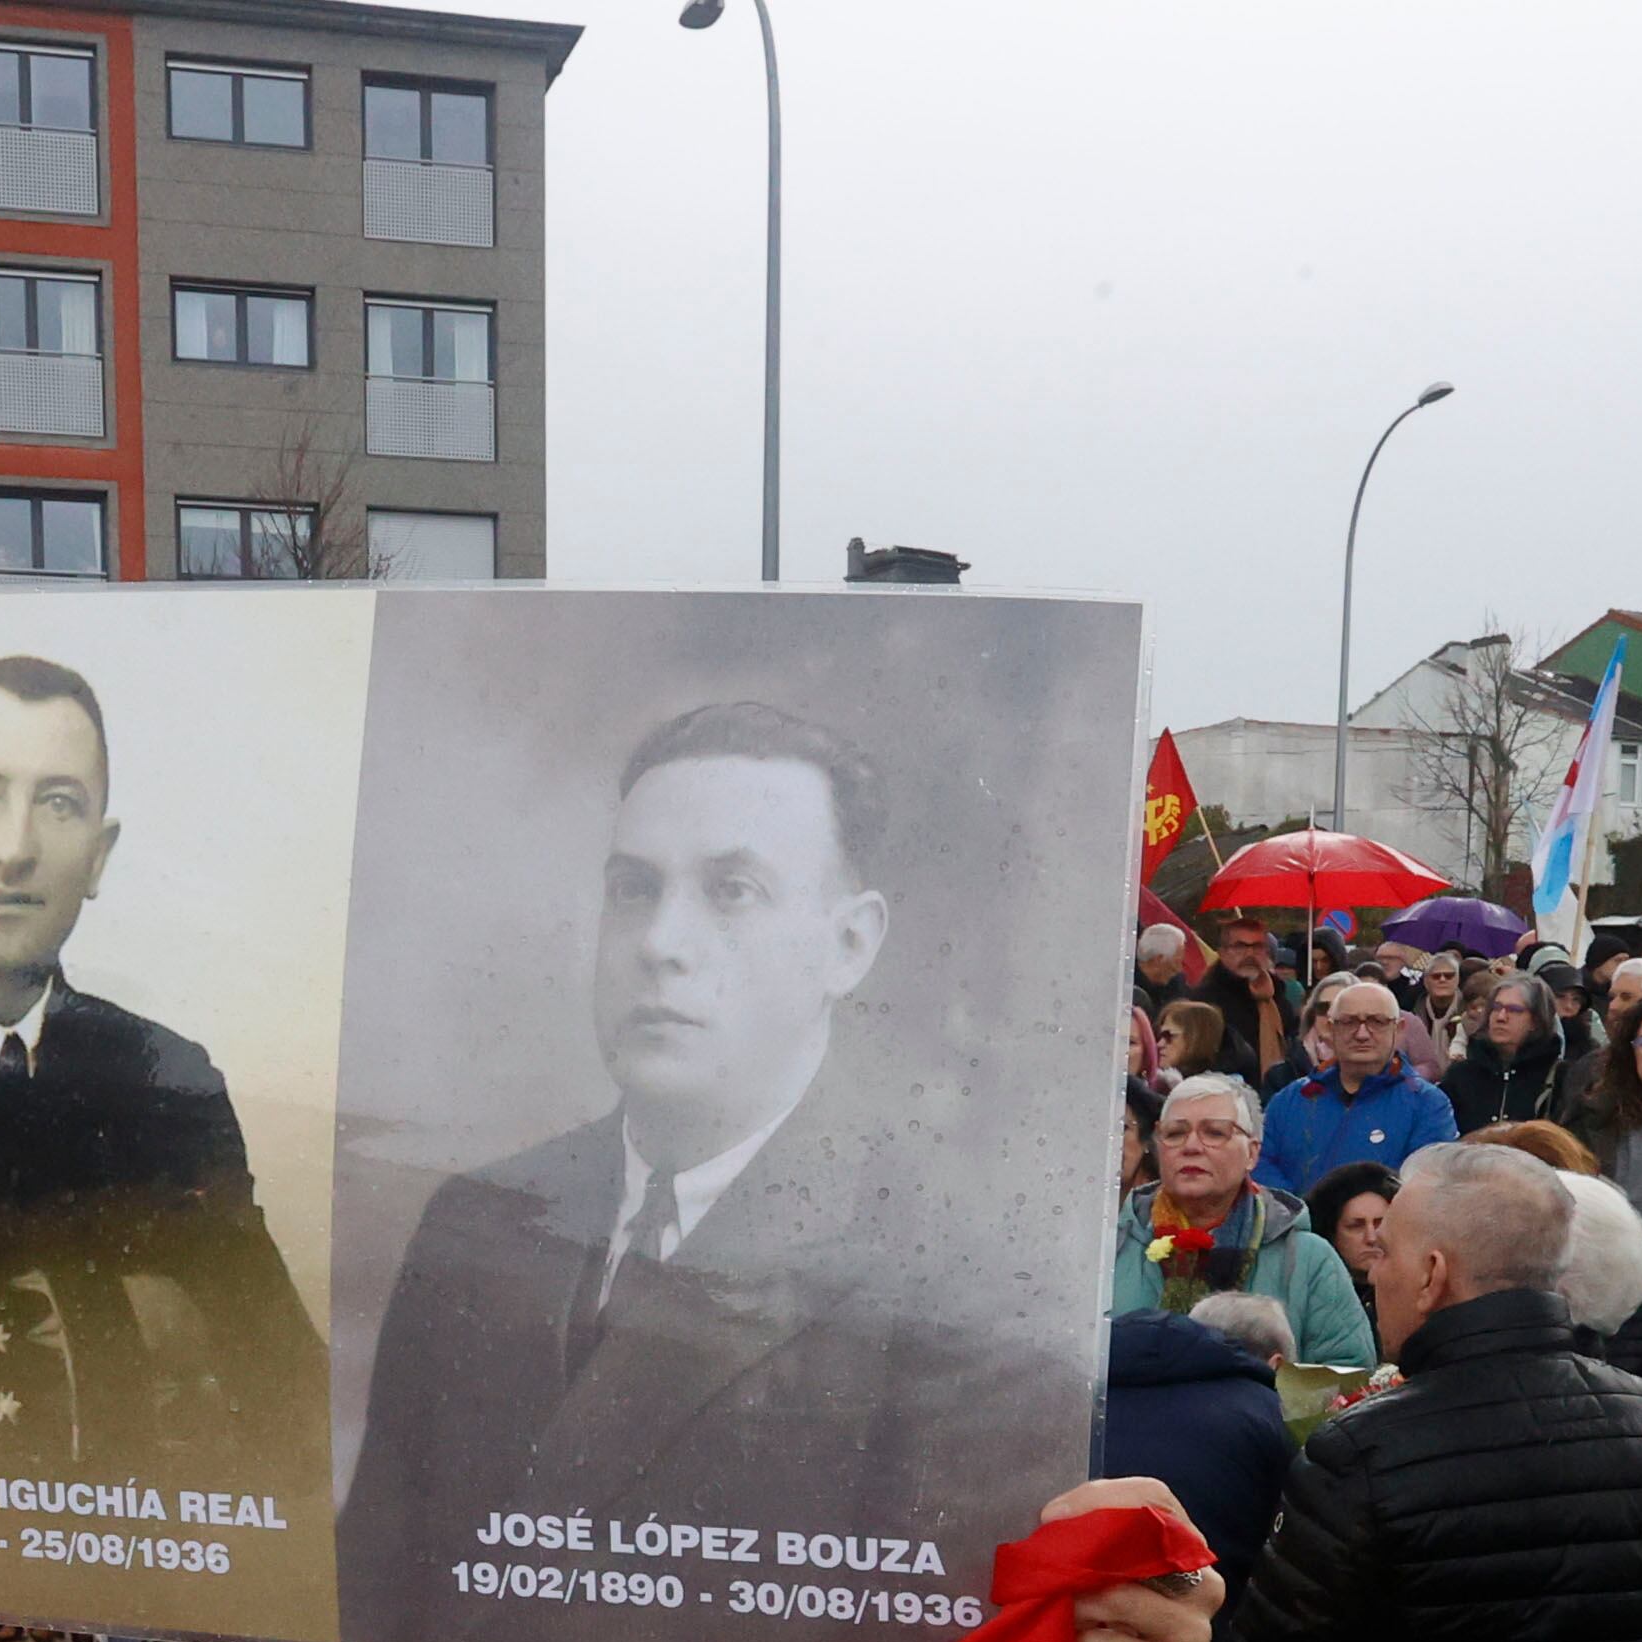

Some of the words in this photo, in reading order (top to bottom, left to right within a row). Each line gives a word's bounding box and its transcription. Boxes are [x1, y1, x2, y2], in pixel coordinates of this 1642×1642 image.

[179, 1491, 287, 1529] REAL
[20, 1527, 230, 1574] 25/08/1936
[477, 1508, 594, 1551] JOSÉ
[609, 1512, 760, 1562] LÓPEZ
[777, 1531, 946, 1575] BOUZA
[452, 1561, 684, 1609] 19/02/1890
[729, 1581, 982, 1627] 30/08/1936
